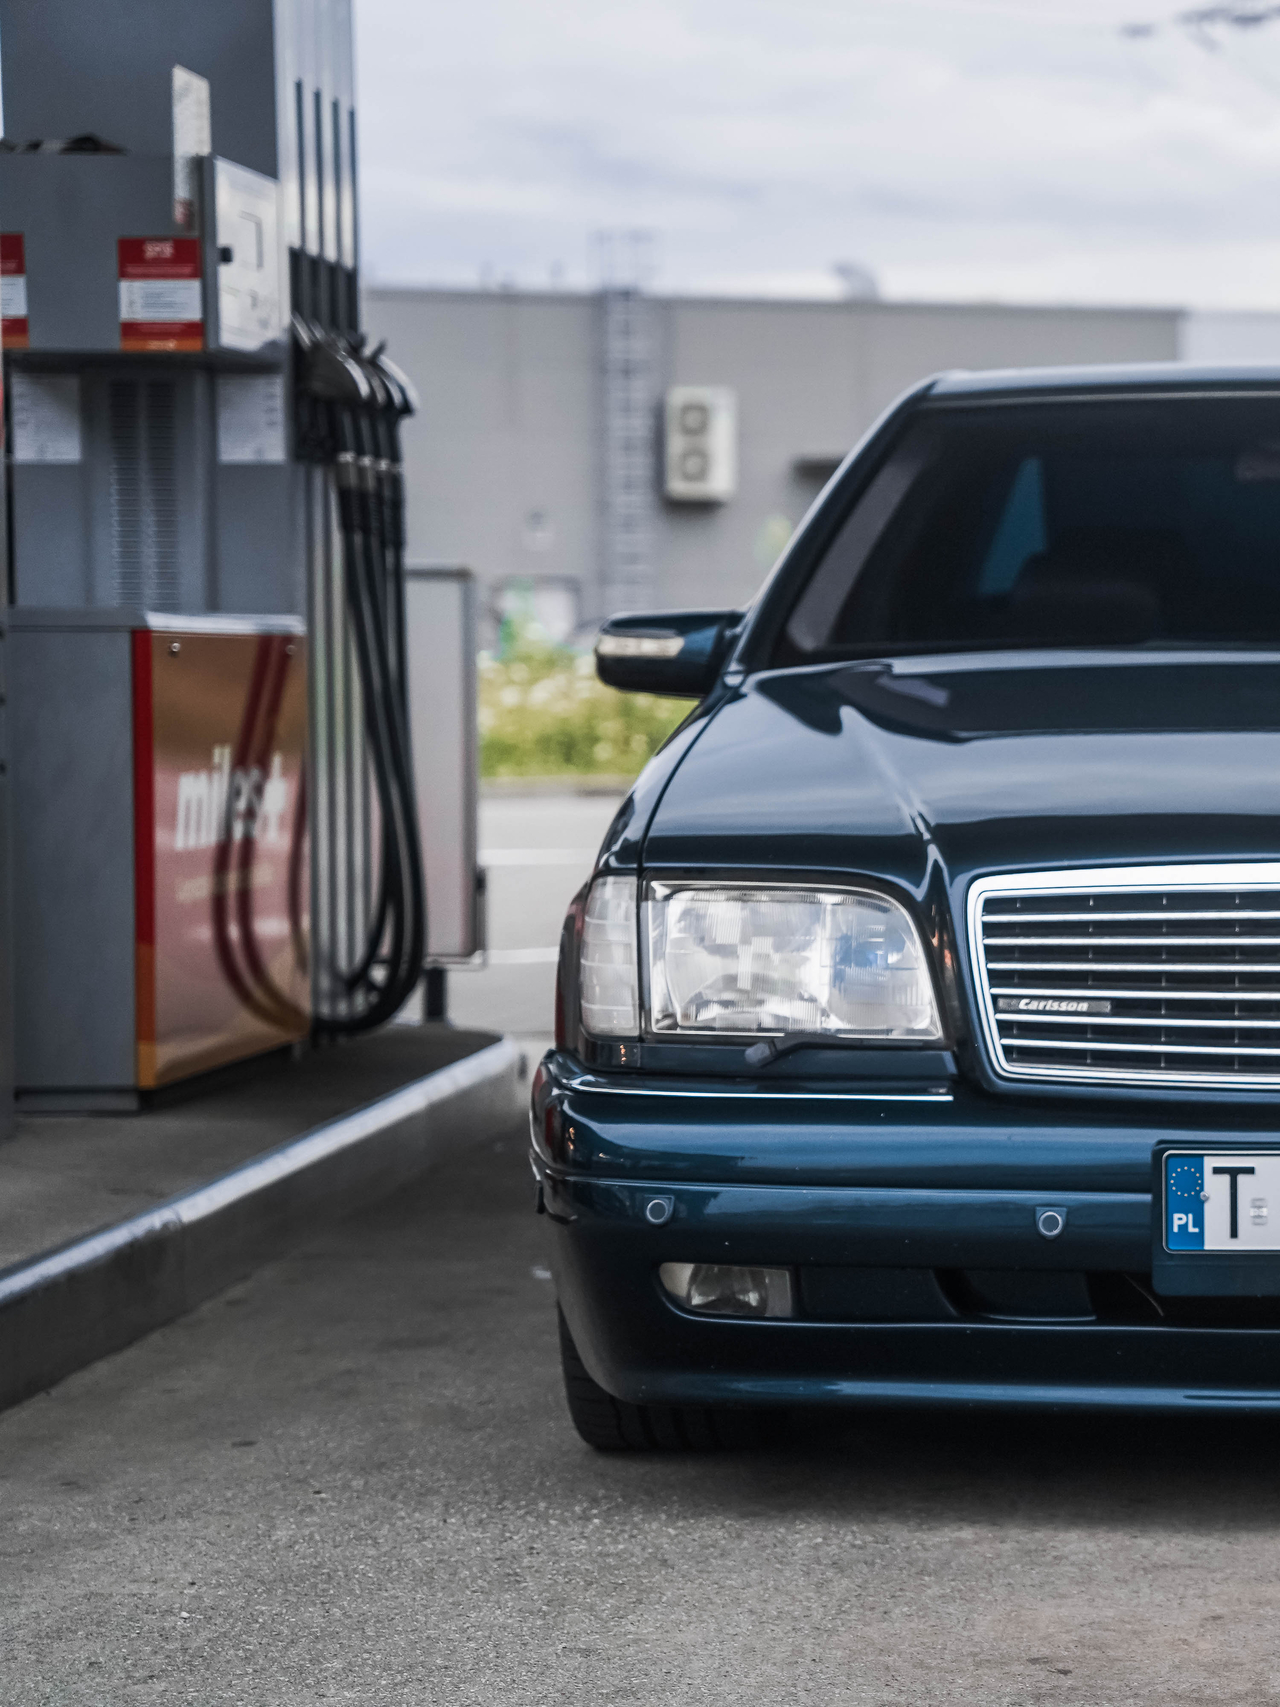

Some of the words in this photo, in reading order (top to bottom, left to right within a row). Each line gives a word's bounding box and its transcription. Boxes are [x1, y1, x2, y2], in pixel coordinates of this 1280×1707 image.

[1018, 998, 1090, 1012] Carlsson
[1212, 1166, 1255, 1239] T
[1172, 1213, 1199, 1233] PL
